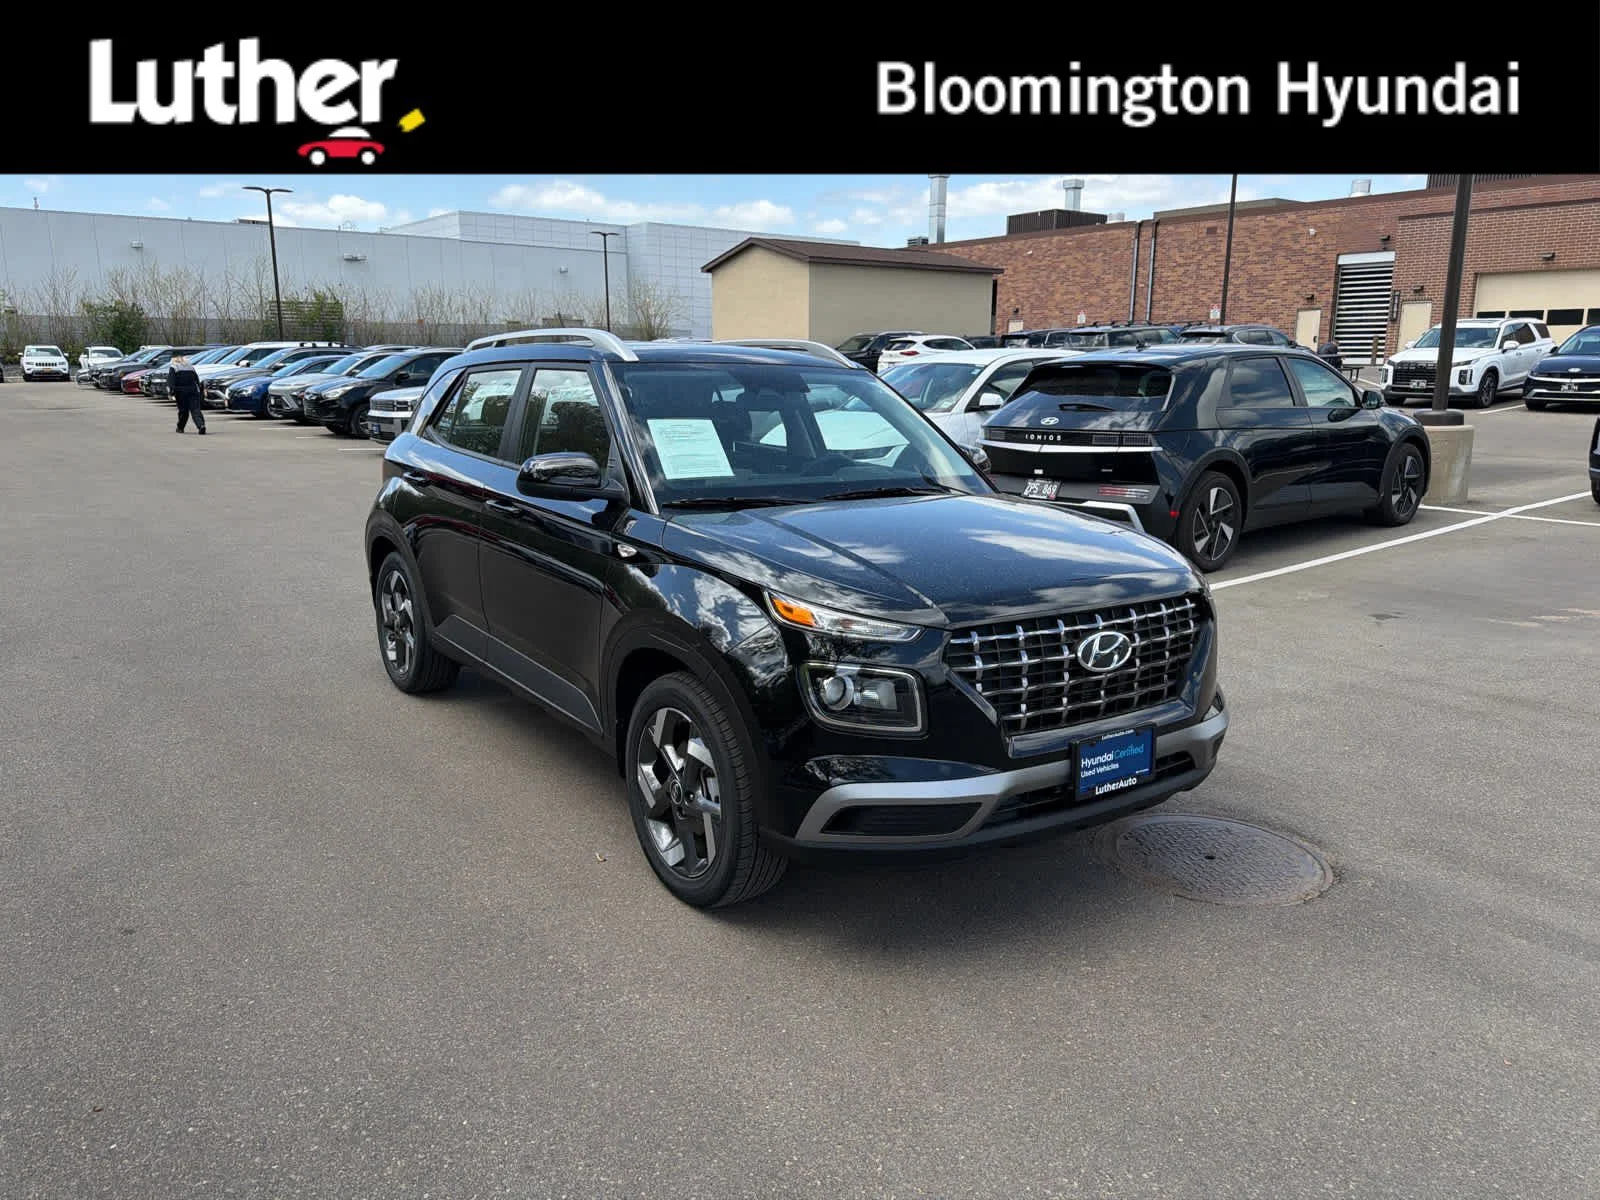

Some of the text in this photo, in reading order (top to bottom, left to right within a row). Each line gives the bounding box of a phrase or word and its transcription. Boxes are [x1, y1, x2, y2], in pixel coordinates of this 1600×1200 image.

[1081, 750, 1114, 768] Hyundai
[1080, 763, 1119, 778] Used Vehicles
[1095, 776, 1137, 795] LutherAuto
